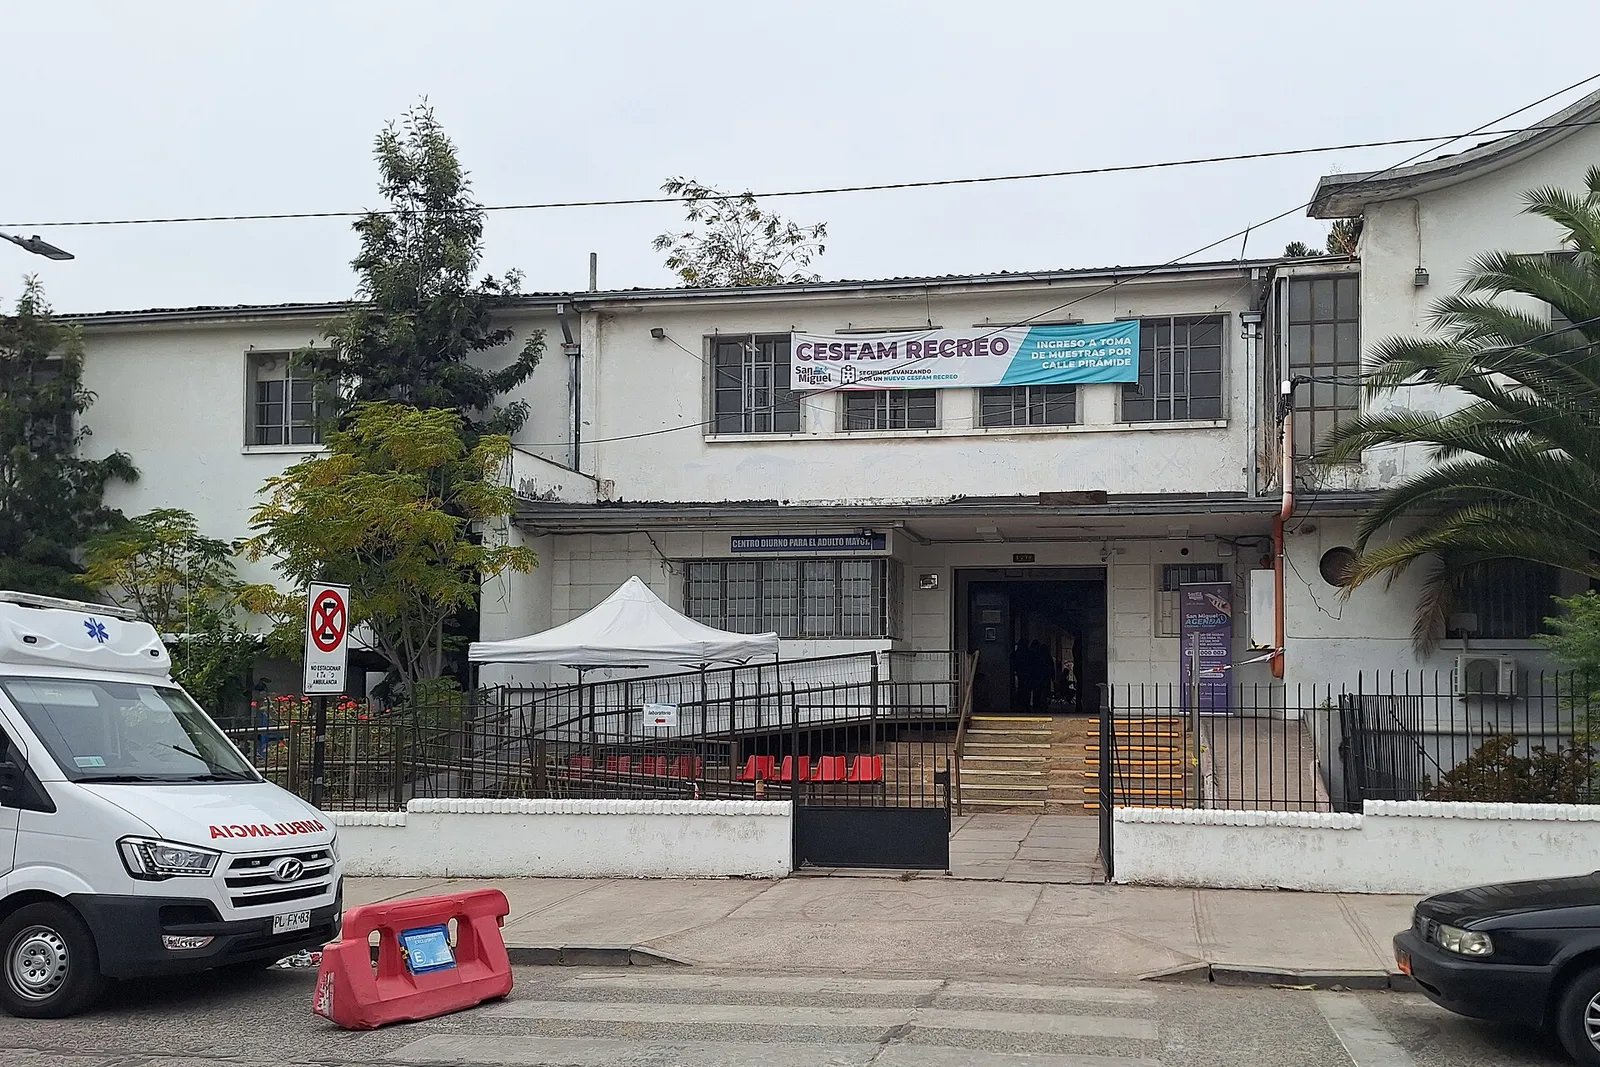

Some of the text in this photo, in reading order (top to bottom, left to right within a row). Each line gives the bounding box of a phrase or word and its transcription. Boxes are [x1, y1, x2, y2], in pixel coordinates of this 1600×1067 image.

[796, 337, 1010, 361] CESFAM RECREO
[1036, 337, 1132, 349] INGRESO A TOMA
[1031, 347, 1132, 360] DE MUESTRAS POR
[1042, 357, 1132, 369] CALLE PIRÁMIDE
[795, 365, 813, 375] San
[798, 372, 832, 385] Miguel
[732, 538, 760, 548] CENTRO
[761, 538, 788, 548] DIURNO
[789, 538, 808, 547] PARA
[808, 538, 817, 547] EL
[817, 537, 844, 547] ADULTO
[274, 916, 285, 929] PL
[413, 951, 424, 963] E
